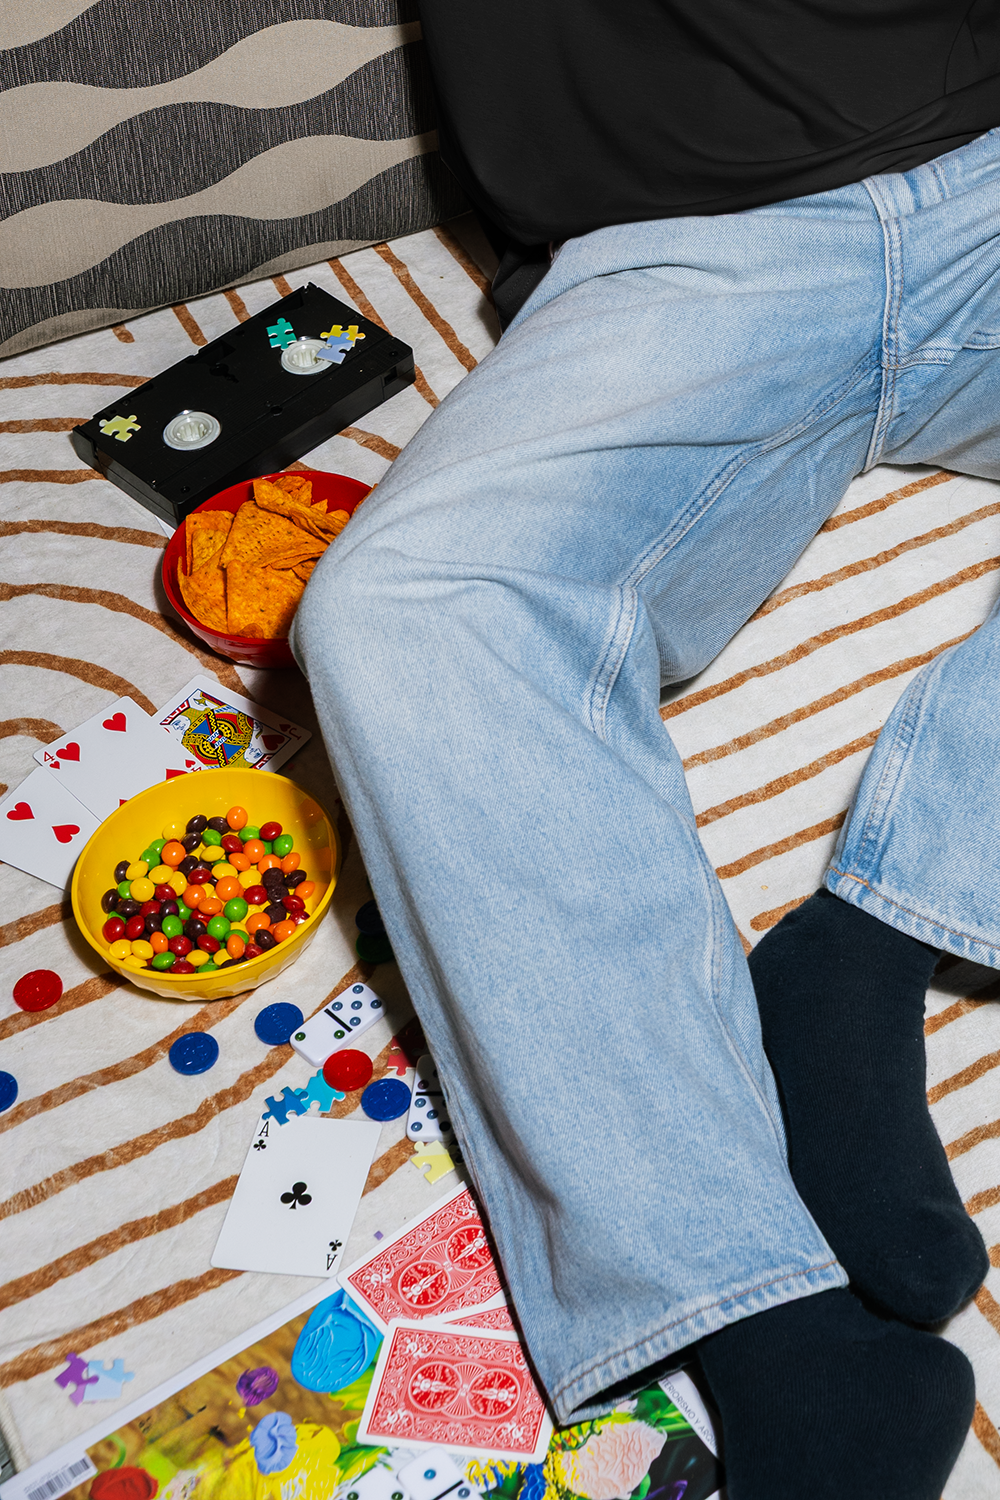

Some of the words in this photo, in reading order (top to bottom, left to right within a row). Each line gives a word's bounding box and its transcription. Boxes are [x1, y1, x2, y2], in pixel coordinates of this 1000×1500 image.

[43, 751, 56, 763] 4
[258, 1121, 270, 1137] A
[326, 1254, 338, 1271] A
